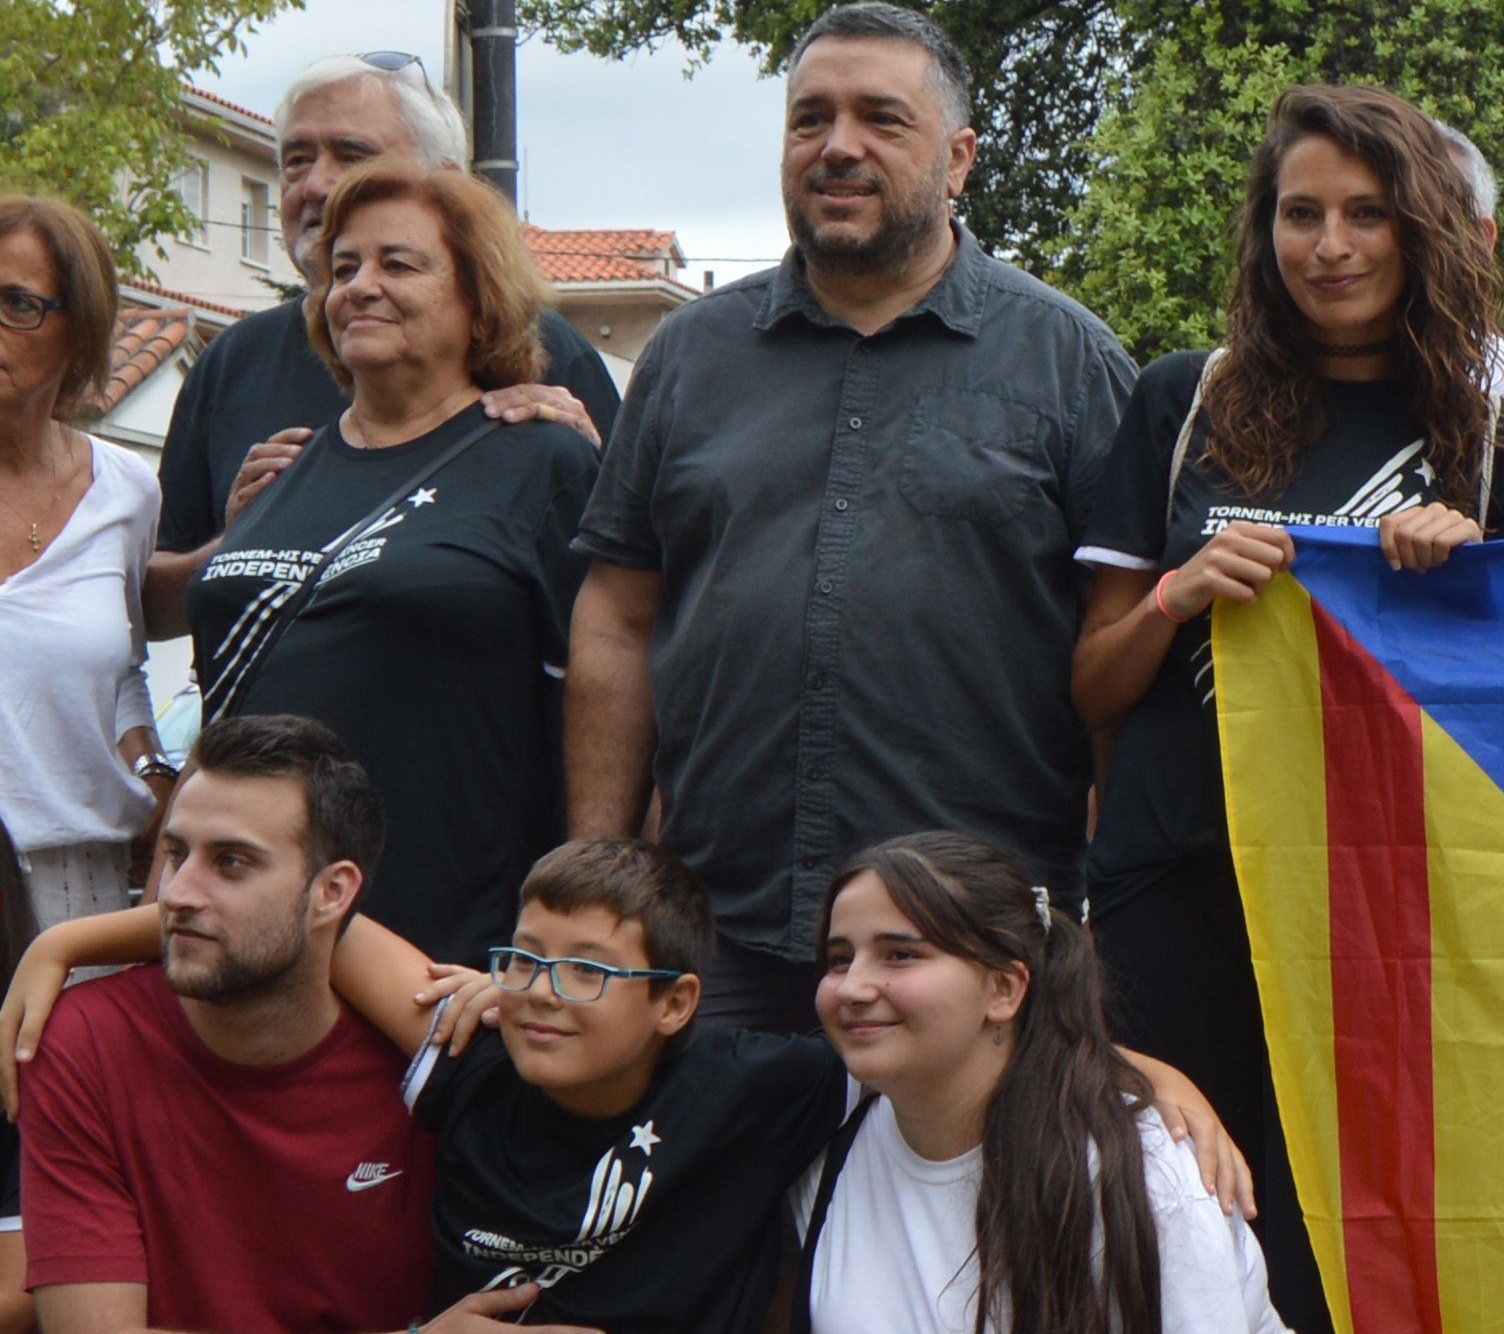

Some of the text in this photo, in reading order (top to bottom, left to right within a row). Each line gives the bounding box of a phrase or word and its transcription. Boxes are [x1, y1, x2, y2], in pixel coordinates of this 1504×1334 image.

[1208, 505, 1313, 526] TORNEM-HI
[1314, 514, 1349, 527] PER
[210, 548, 301, 565] TORNEM-HI
[301, 551, 324, 565] PE
[355, 1162, 389, 1180] NIKE
